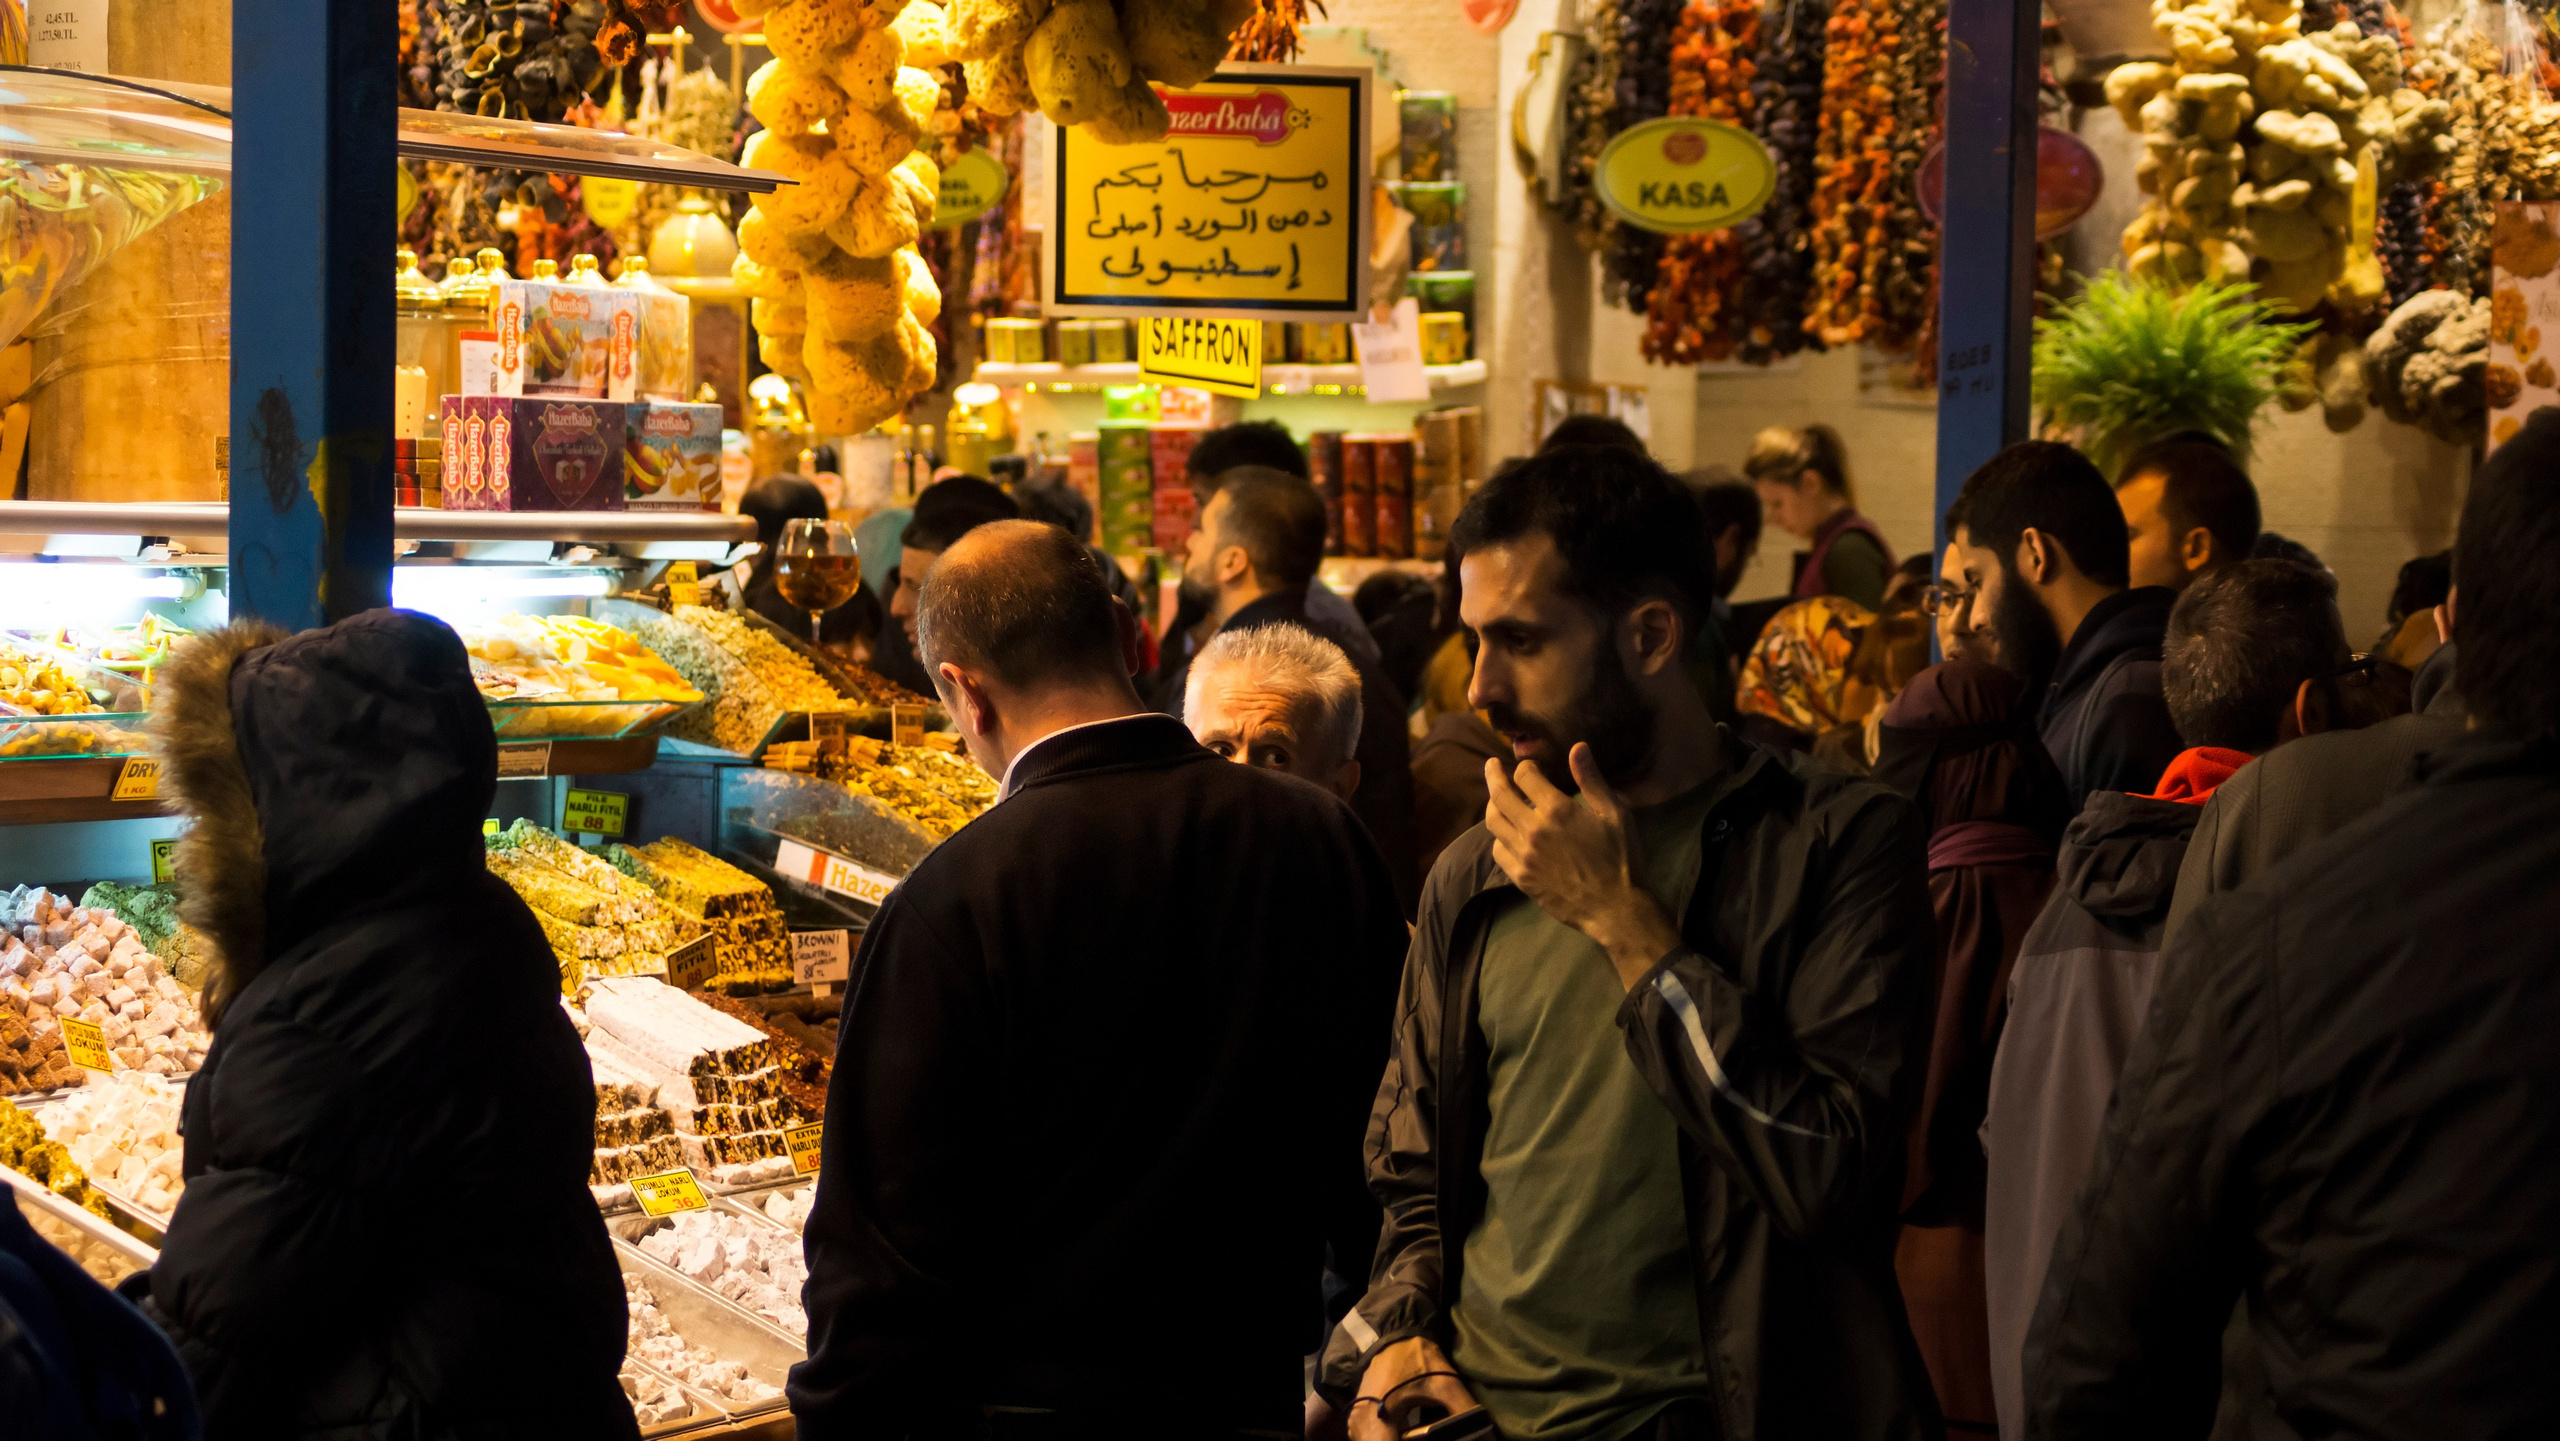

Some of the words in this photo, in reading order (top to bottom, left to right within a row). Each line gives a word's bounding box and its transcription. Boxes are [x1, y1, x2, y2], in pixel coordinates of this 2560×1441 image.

[1162, 101, 1281, 131] azerBaba
[1639, 182, 1731, 208] KASA
[506, 308, 517, 368] HazerBaba
[1152, 318, 1250, 367] SAFFRON
[618, 316, 630, 377] HazerBaba
[548, 411, 593, 427] HazerBaba
[448, 423, 458, 485] HazerBaba
[470, 423, 480, 485] HazerBaba
[494, 423, 505, 486] HazerBaba
[127, 762, 160, 778] DRY
[583, 815, 604, 830] 88
[70, 1036, 105, 1053] LOKUM
[93, 1053, 108, 1068] 36
[795, 1128, 822, 1139] EXTRA
[791, 1141, 811, 1153] NARLI
[669, 1175, 691, 1187] NARLI
[656, 1187, 681, 1198] LOKUM
[672, 1196, 694, 1209] 36
